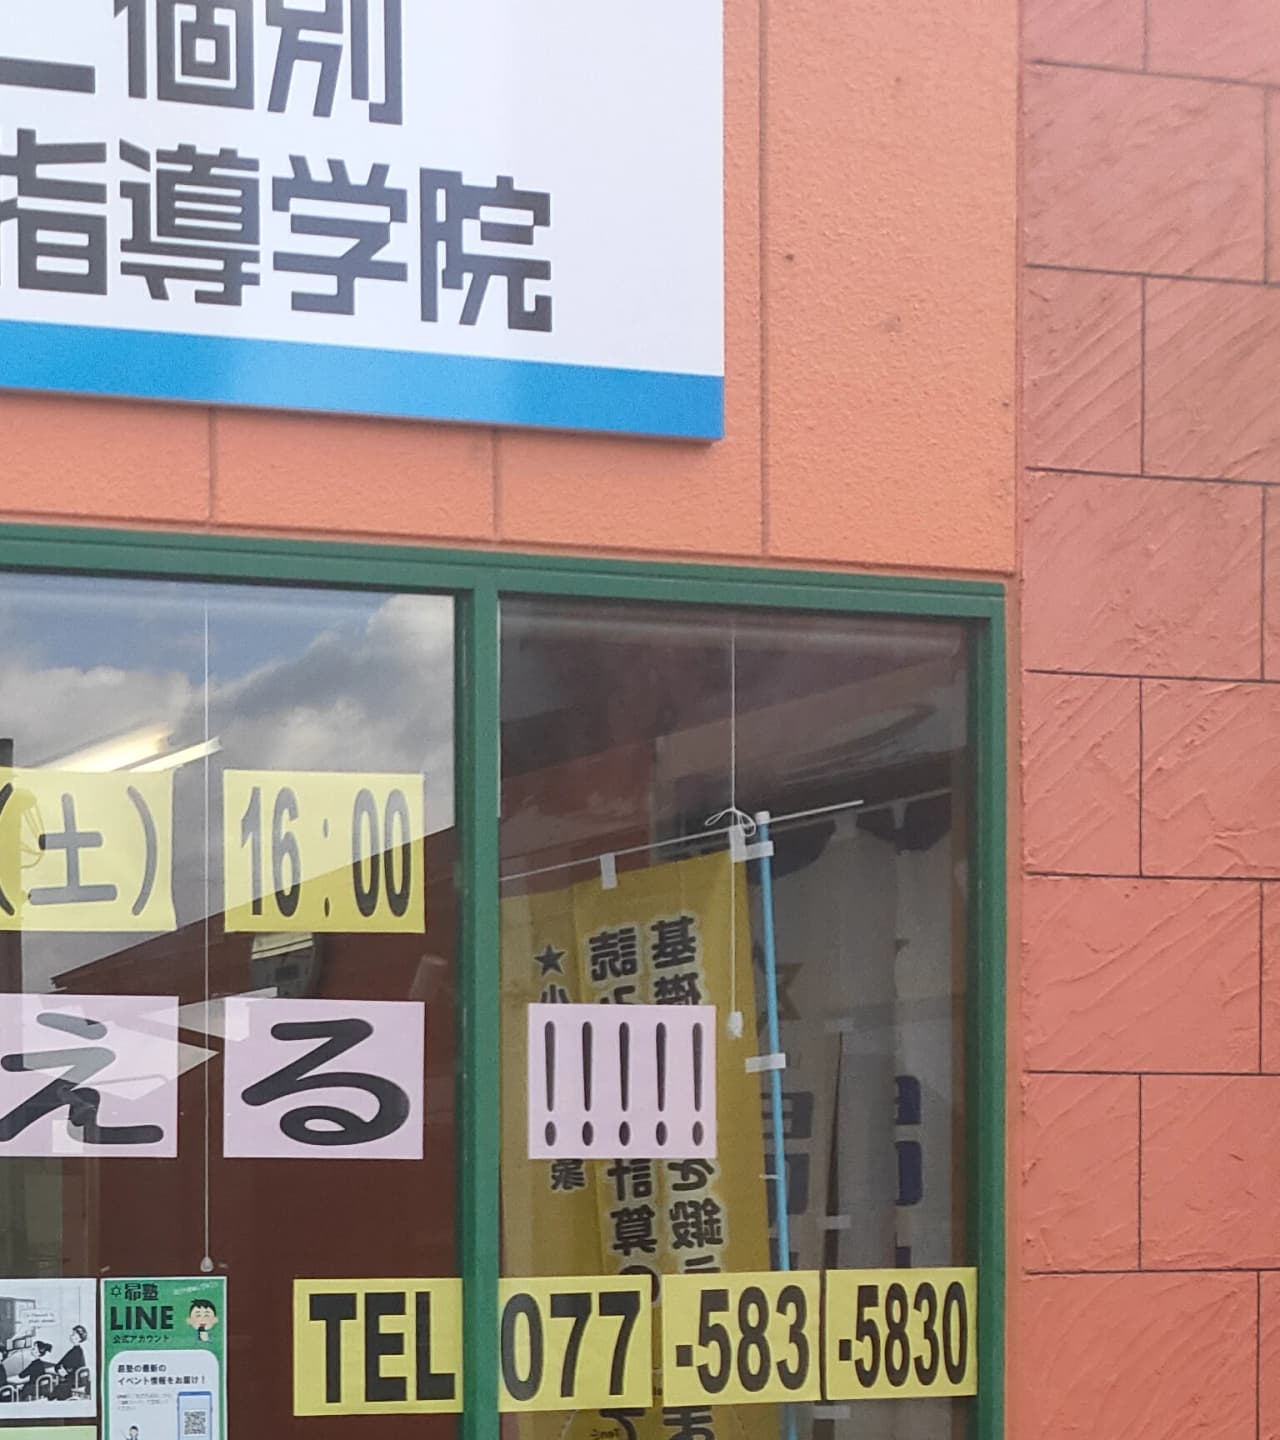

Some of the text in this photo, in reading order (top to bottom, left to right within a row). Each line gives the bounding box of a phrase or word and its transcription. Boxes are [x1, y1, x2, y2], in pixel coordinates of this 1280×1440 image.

[109, 1305, 174, 1331] LINE
[112, 1334, 170, 1345] 公式アカウント
[309, 1290, 457, 1404] TEL
